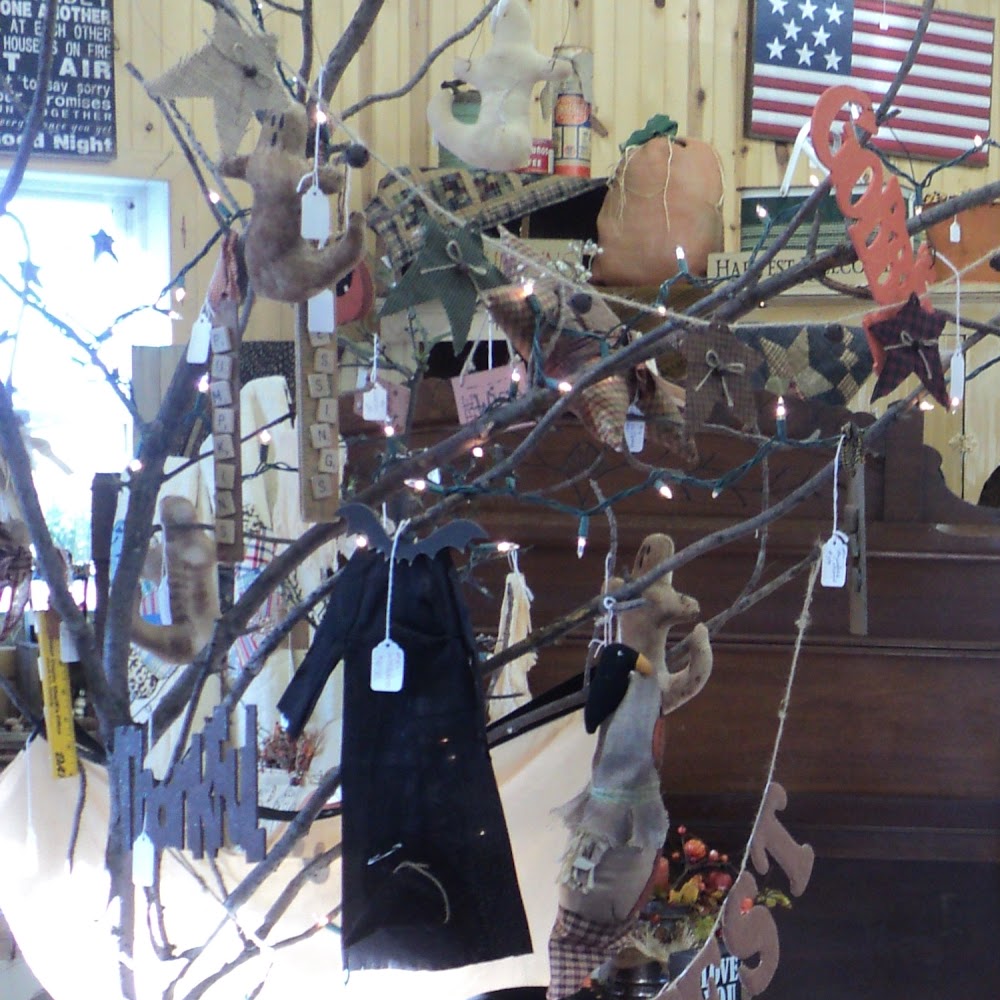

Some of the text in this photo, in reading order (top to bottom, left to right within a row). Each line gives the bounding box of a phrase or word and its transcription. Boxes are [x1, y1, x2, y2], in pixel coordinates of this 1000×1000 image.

[1, 1, 32, 18] ONE
[74, 24, 111, 42] OTHER
[3, 35, 40, 54] HOUSE
[65, 41, 80, 57] ON
[88, 43, 111, 59] FIRE
[59, 56, 111, 80] AIR
[77, 82, 111, 99] sorry
[46, 95, 111, 110] romises
[53, 132, 113, 154] Night
